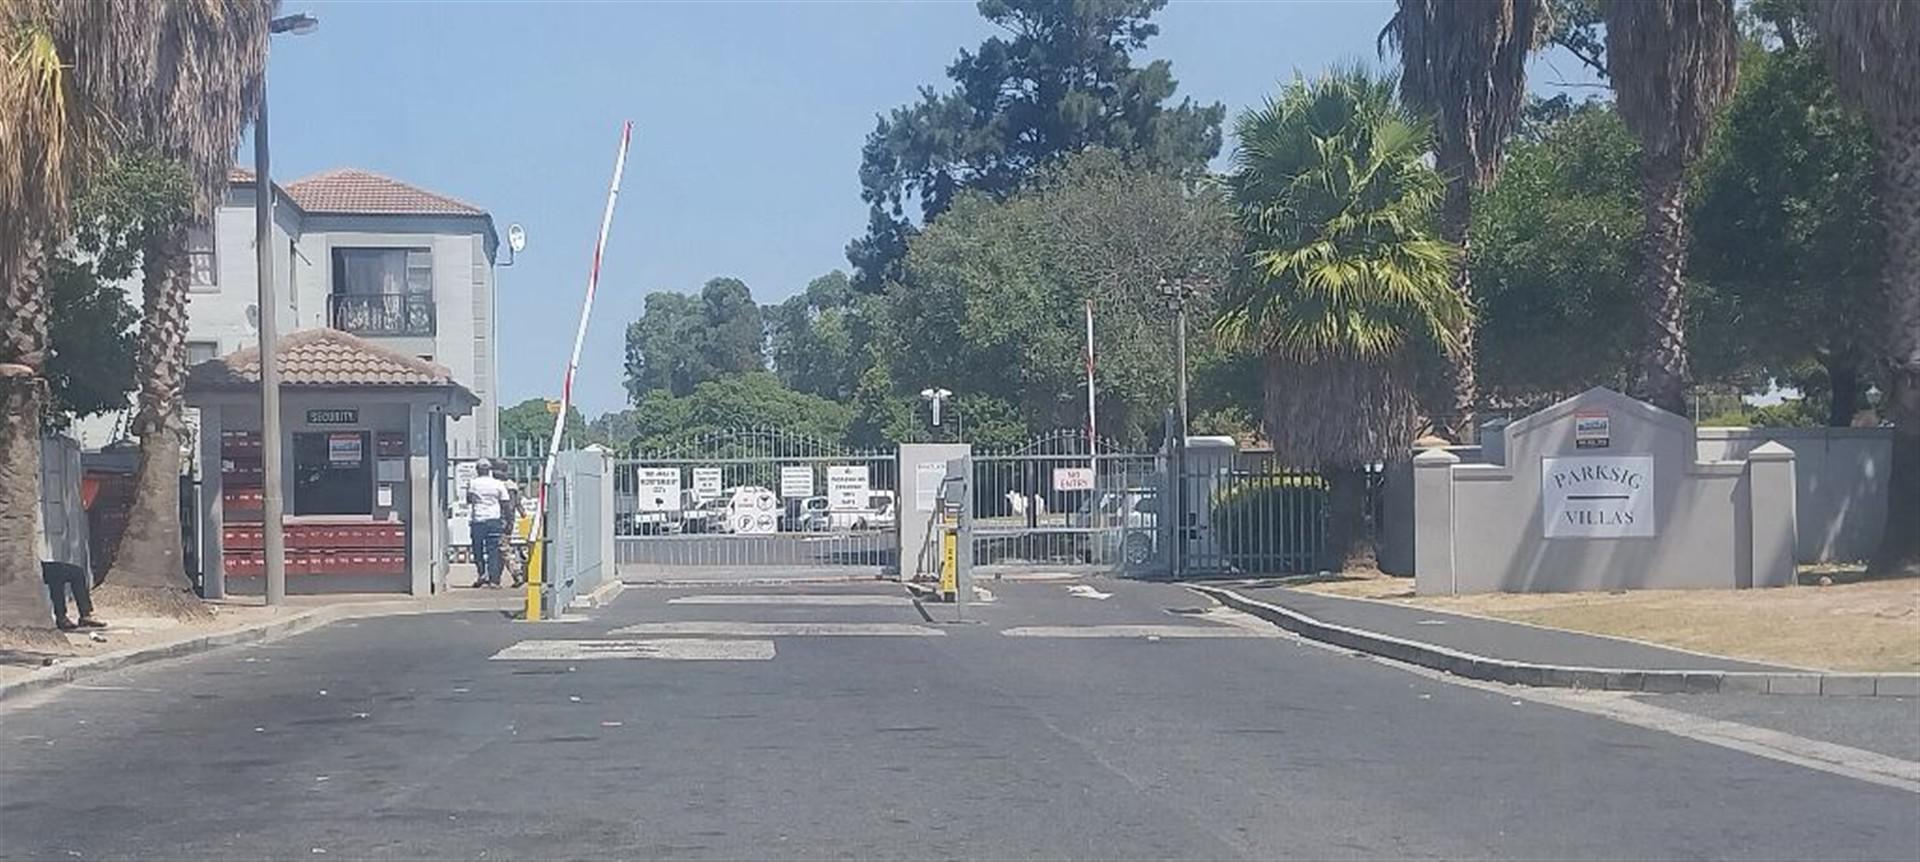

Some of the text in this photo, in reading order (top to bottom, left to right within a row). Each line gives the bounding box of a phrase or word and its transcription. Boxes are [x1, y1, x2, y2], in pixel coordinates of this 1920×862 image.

[310, 411, 355, 422] SECURITY
[1060, 479, 1088, 488] ENTRY
[1553, 465, 1643, 489] PARKSIG
[1565, 510, 1634, 525] VILLAS
